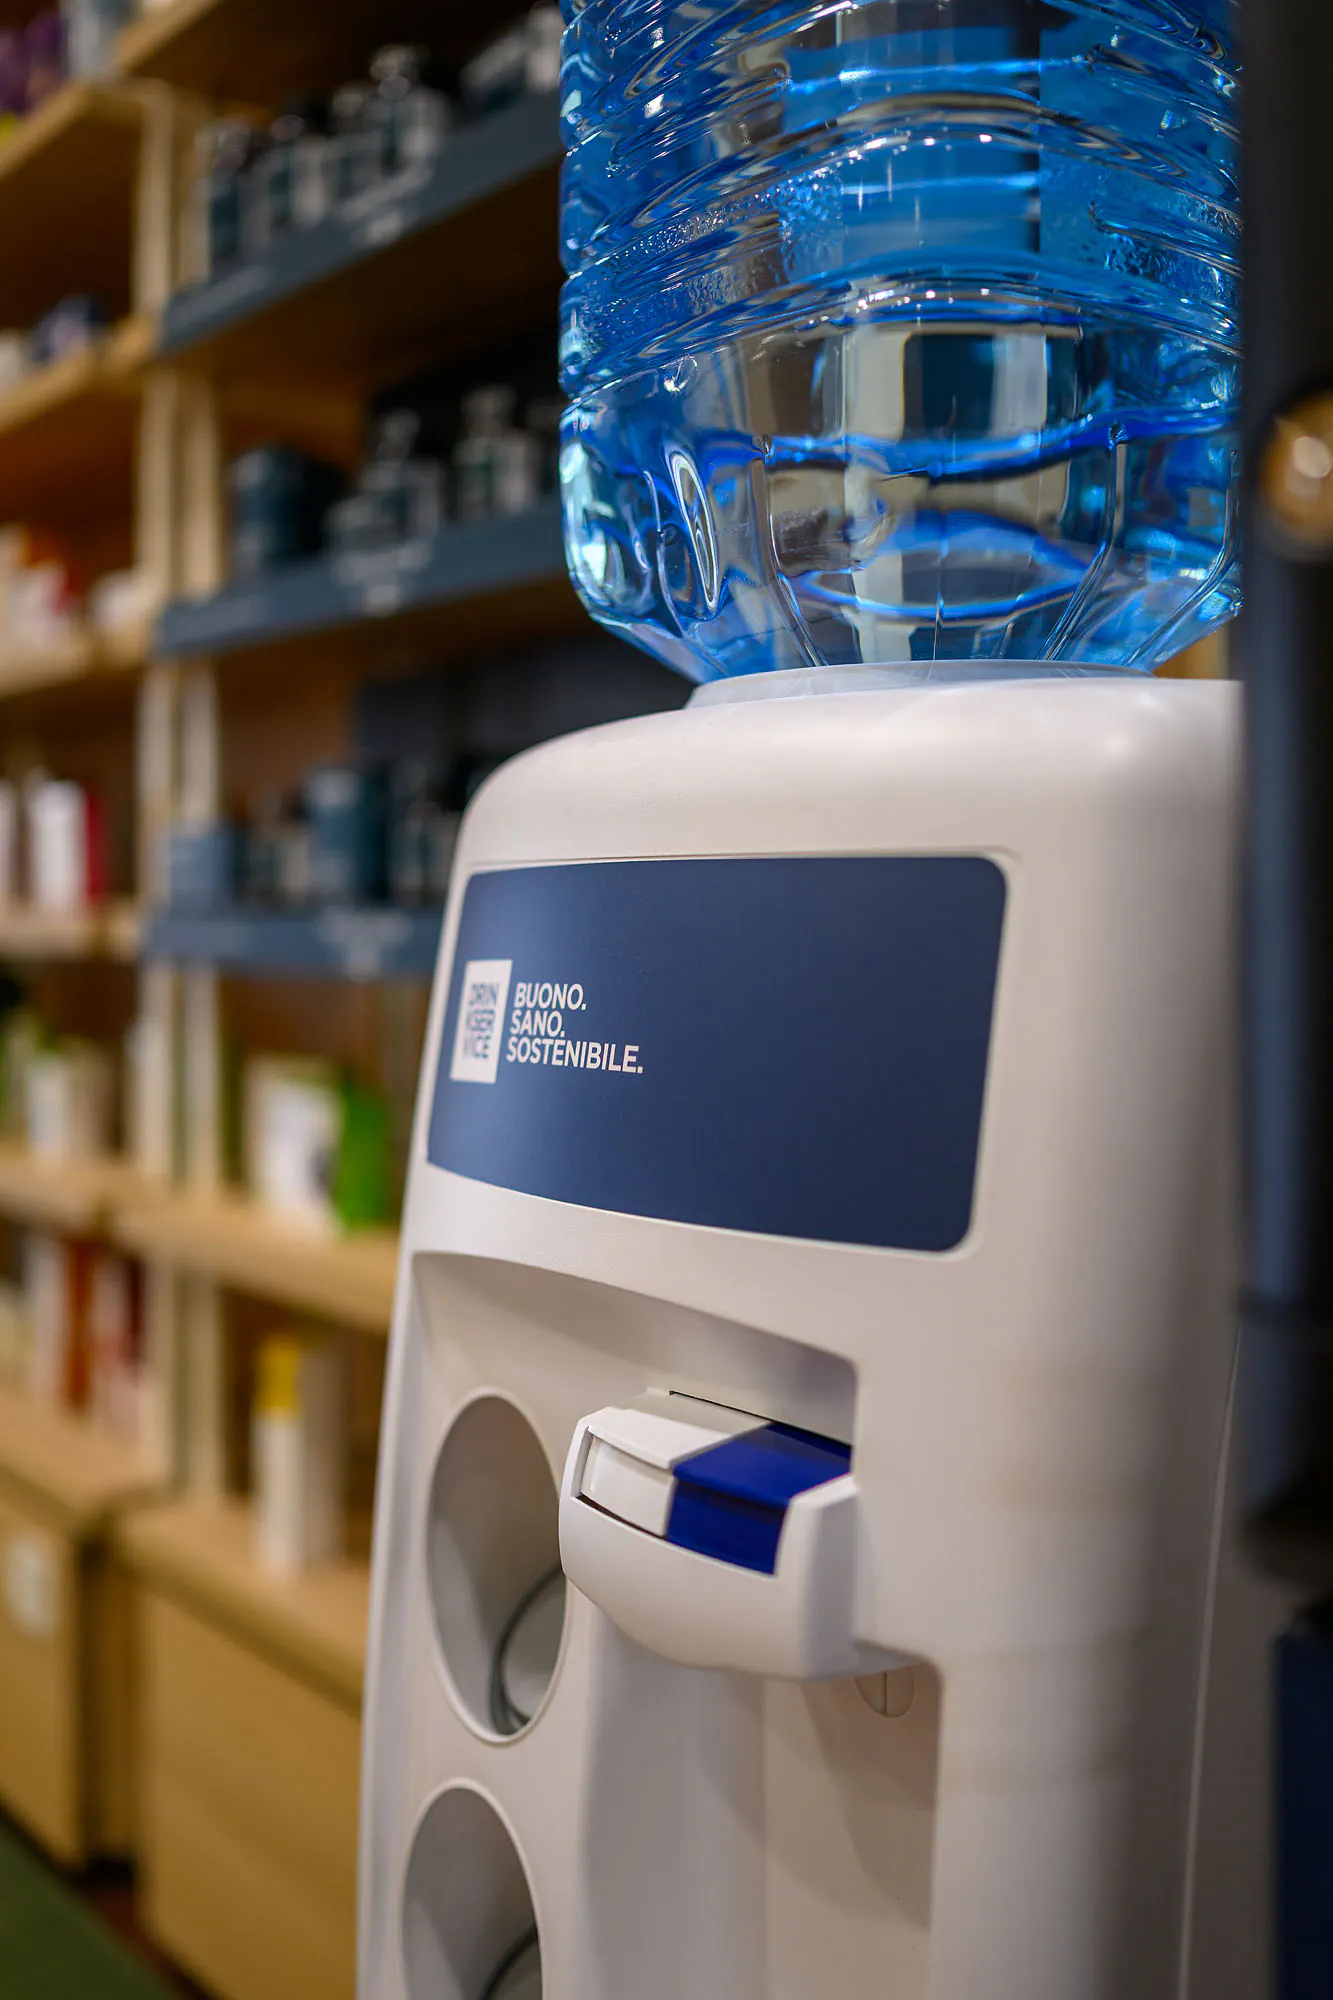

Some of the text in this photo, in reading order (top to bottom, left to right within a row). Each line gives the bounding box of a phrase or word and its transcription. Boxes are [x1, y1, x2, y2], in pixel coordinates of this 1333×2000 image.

[514, 982, 587, 1011] BUONO.
[510, 1009, 565, 1038] SANO.
[506, 1035, 643, 1074] SOSTENIBILE.
